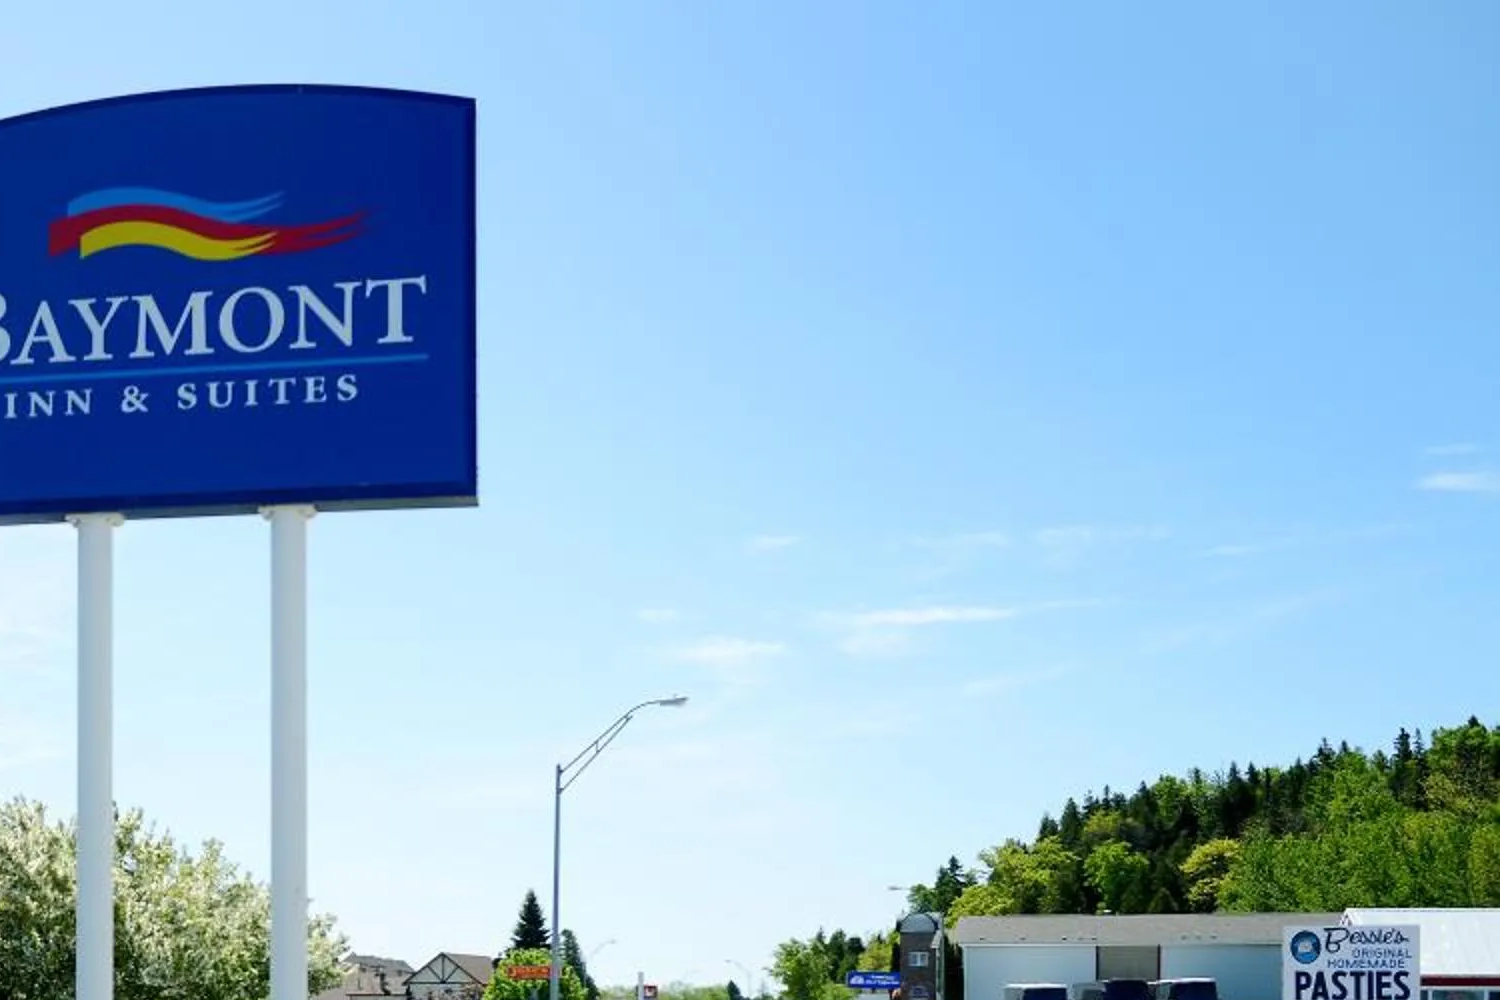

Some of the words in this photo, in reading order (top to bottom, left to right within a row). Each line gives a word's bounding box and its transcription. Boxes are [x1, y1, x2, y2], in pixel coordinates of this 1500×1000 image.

[4, 389, 93, 419] INN
[120, 385, 149, 413] &
[177, 374, 359, 410] SUITES
[1327, 959, 1405, 969] HOMEMADE
[1352, 949, 1412, 959] ORIGINAL
[1295, 970, 1411, 1000] PASTIES
